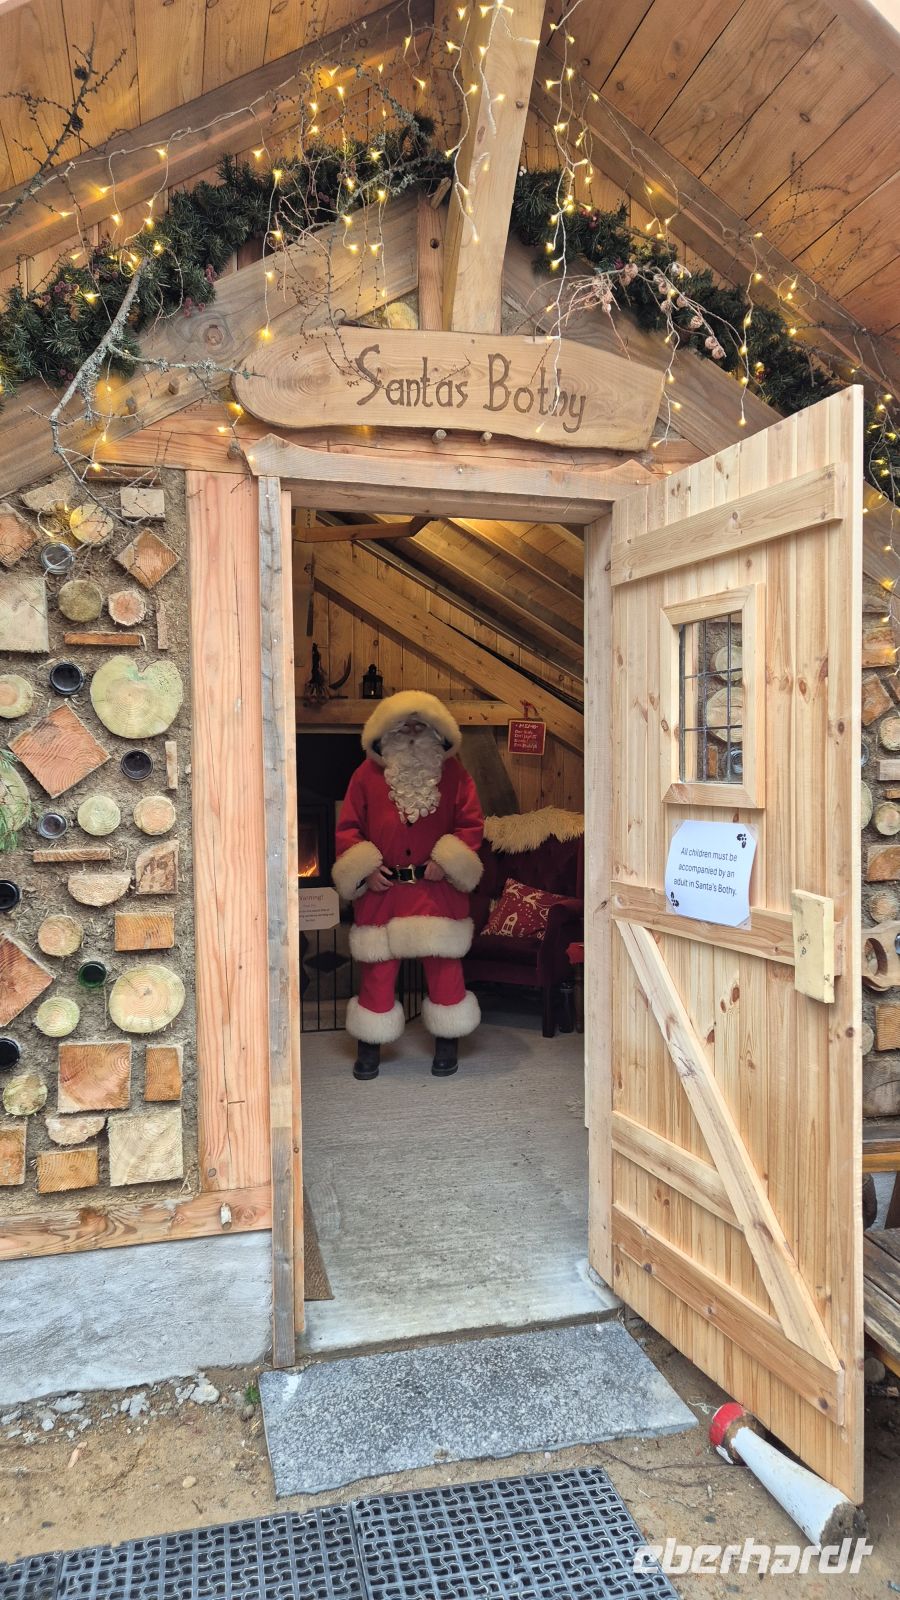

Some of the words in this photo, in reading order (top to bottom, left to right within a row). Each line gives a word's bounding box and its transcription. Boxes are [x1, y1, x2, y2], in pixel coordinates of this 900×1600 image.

[354, 344, 469, 408] Santas
[483, 353, 586, 433] Bothy
[688, 848, 712, 858] children
[712, 852, 728, 861] must
[729, 853, 738, 862] be
[678, 863, 717, 876] accompanied
[718, 869, 726, 879] by
[673, 878, 688, 887] adult
[688, 879, 695, 888] in
[695, 880, 717, 892] Santa's
[718, 883, 737, 896] Bothy.
